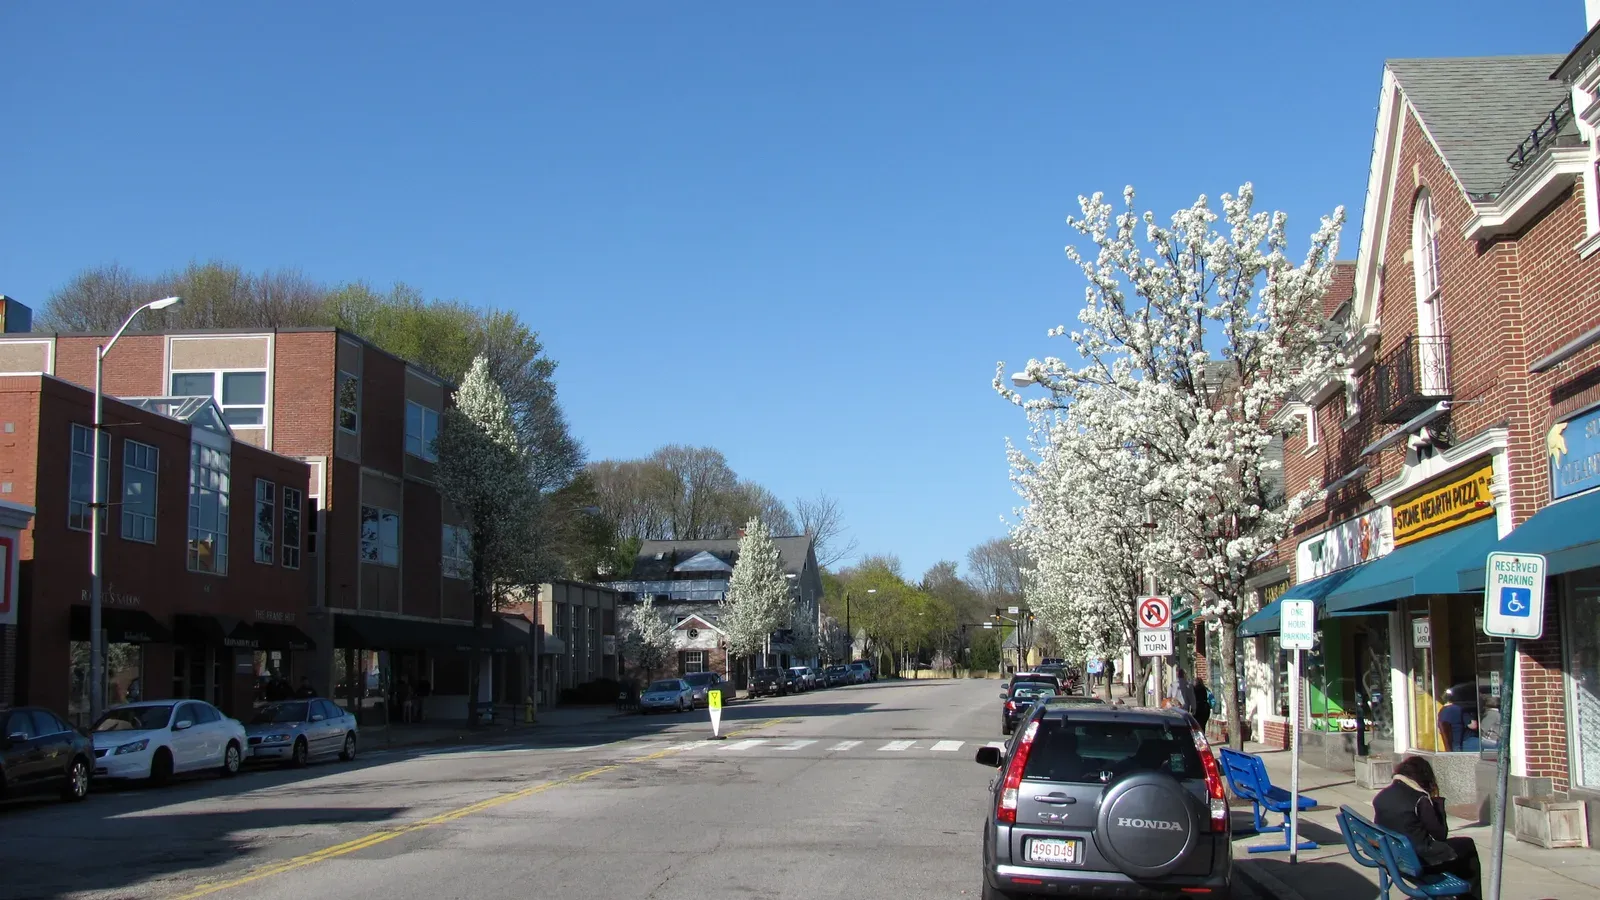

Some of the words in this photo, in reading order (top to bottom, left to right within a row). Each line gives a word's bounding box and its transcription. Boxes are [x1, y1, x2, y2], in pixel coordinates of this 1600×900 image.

[1397, 504, 1420, 530] STONE
[1420, 490, 1452, 521] HEARTH
[1452, 479, 1480, 508] PIZZA
[1495, 560, 1538, 574] RESERVED
[1498, 574, 1534, 587] PARKING
[255, 609, 265, 620] THE
[1290, 608, 1304, 616] ONE
[1288, 620, 1306, 629] HOUR
[1144, 634, 1156, 643] NO
[1160, 634, 1166, 642] U
[1283, 632, 1311, 641] PARKING
[1144, 643, 1167, 651] TURN
[1117, 817, 1183, 831] HONDA
